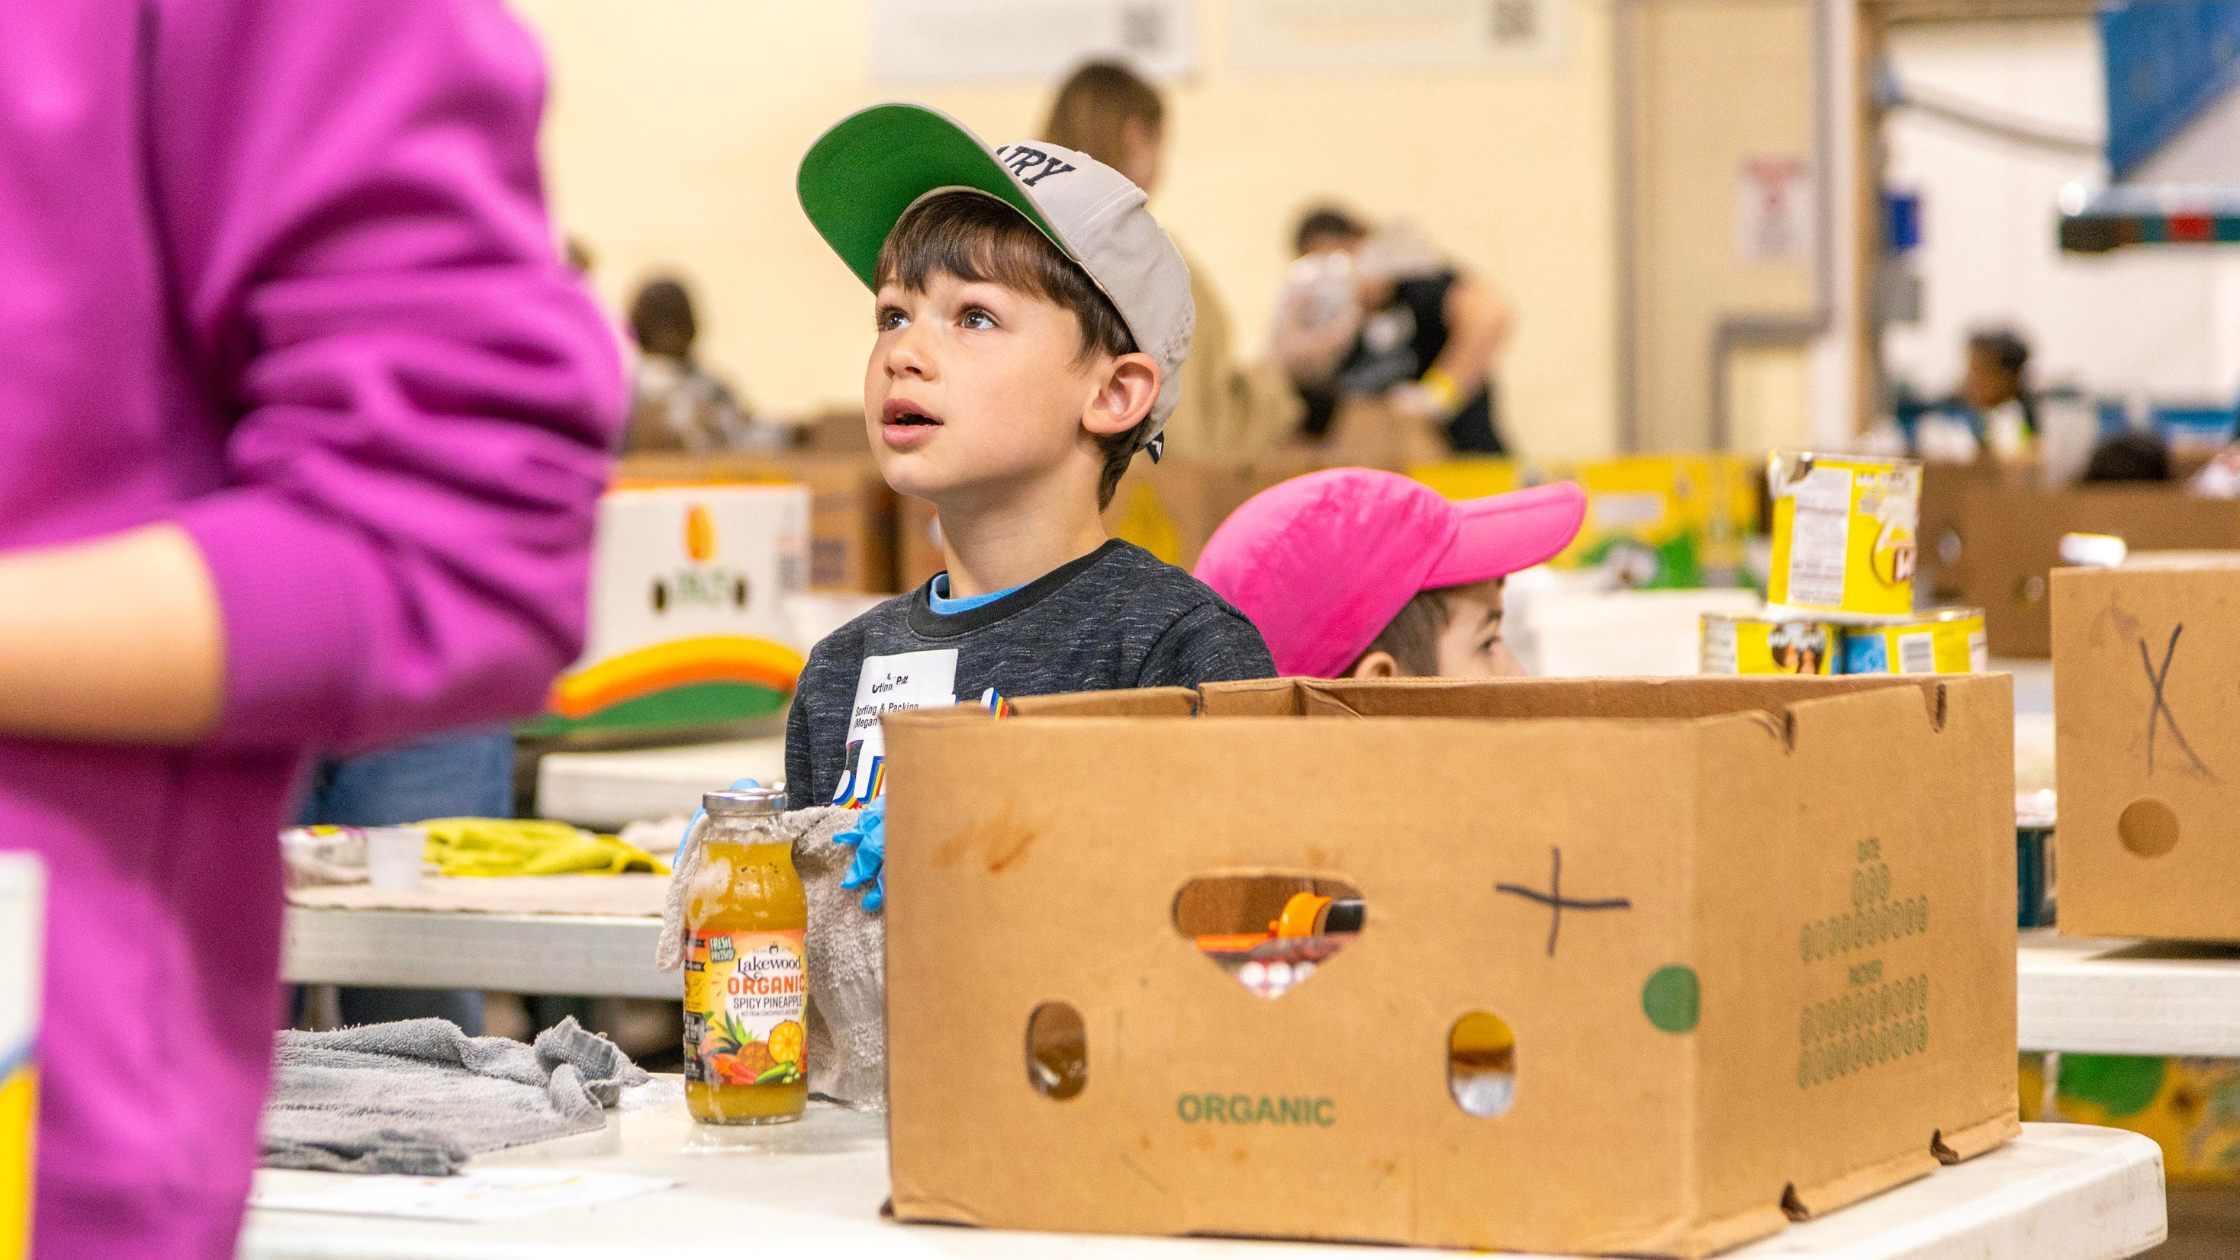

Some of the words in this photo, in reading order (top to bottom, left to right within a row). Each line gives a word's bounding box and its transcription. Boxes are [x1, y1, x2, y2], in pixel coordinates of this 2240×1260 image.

[855, 704, 878, 717] Sorting
[880, 703, 886, 713] &
[738, 955, 802, 982] Lakewood
[727, 974, 805, 995] ORGANIC
[733, 997, 761, 1010] SPICY
[763, 995, 802, 1009] PINEAPPLE
[1177, 1093, 1336, 1128] ORGANIC
